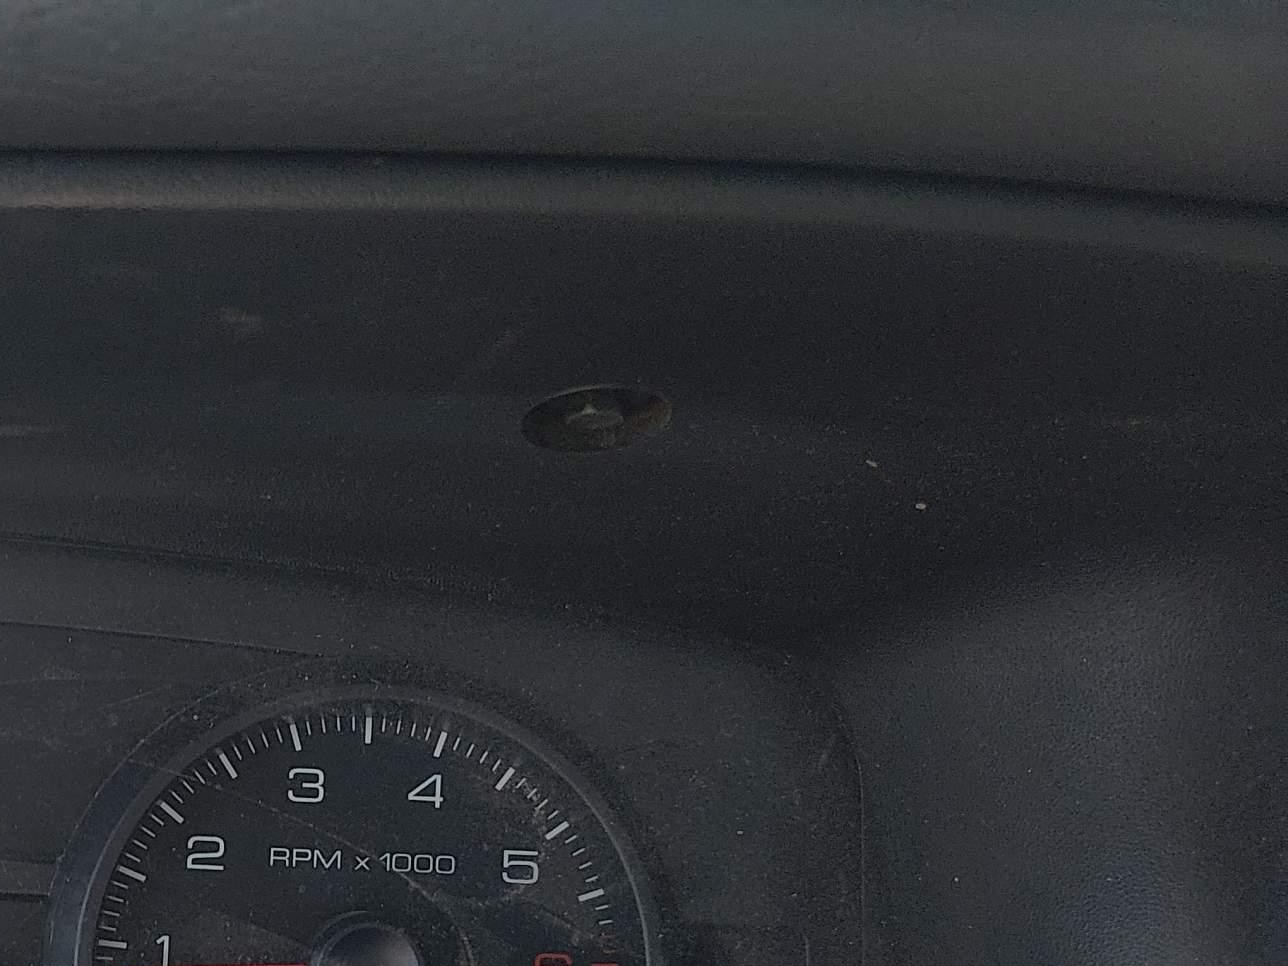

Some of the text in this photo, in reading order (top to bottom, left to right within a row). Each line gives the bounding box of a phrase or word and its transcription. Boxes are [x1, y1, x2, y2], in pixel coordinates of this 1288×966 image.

[288, 768, 325, 802] 3
[408, 774, 443, 808] 4
[186, 835, 225, 870] 2
[269, 847, 342, 869] RPM
[378, 852, 455, 875] 1000
[502, 849, 539, 884] 5
